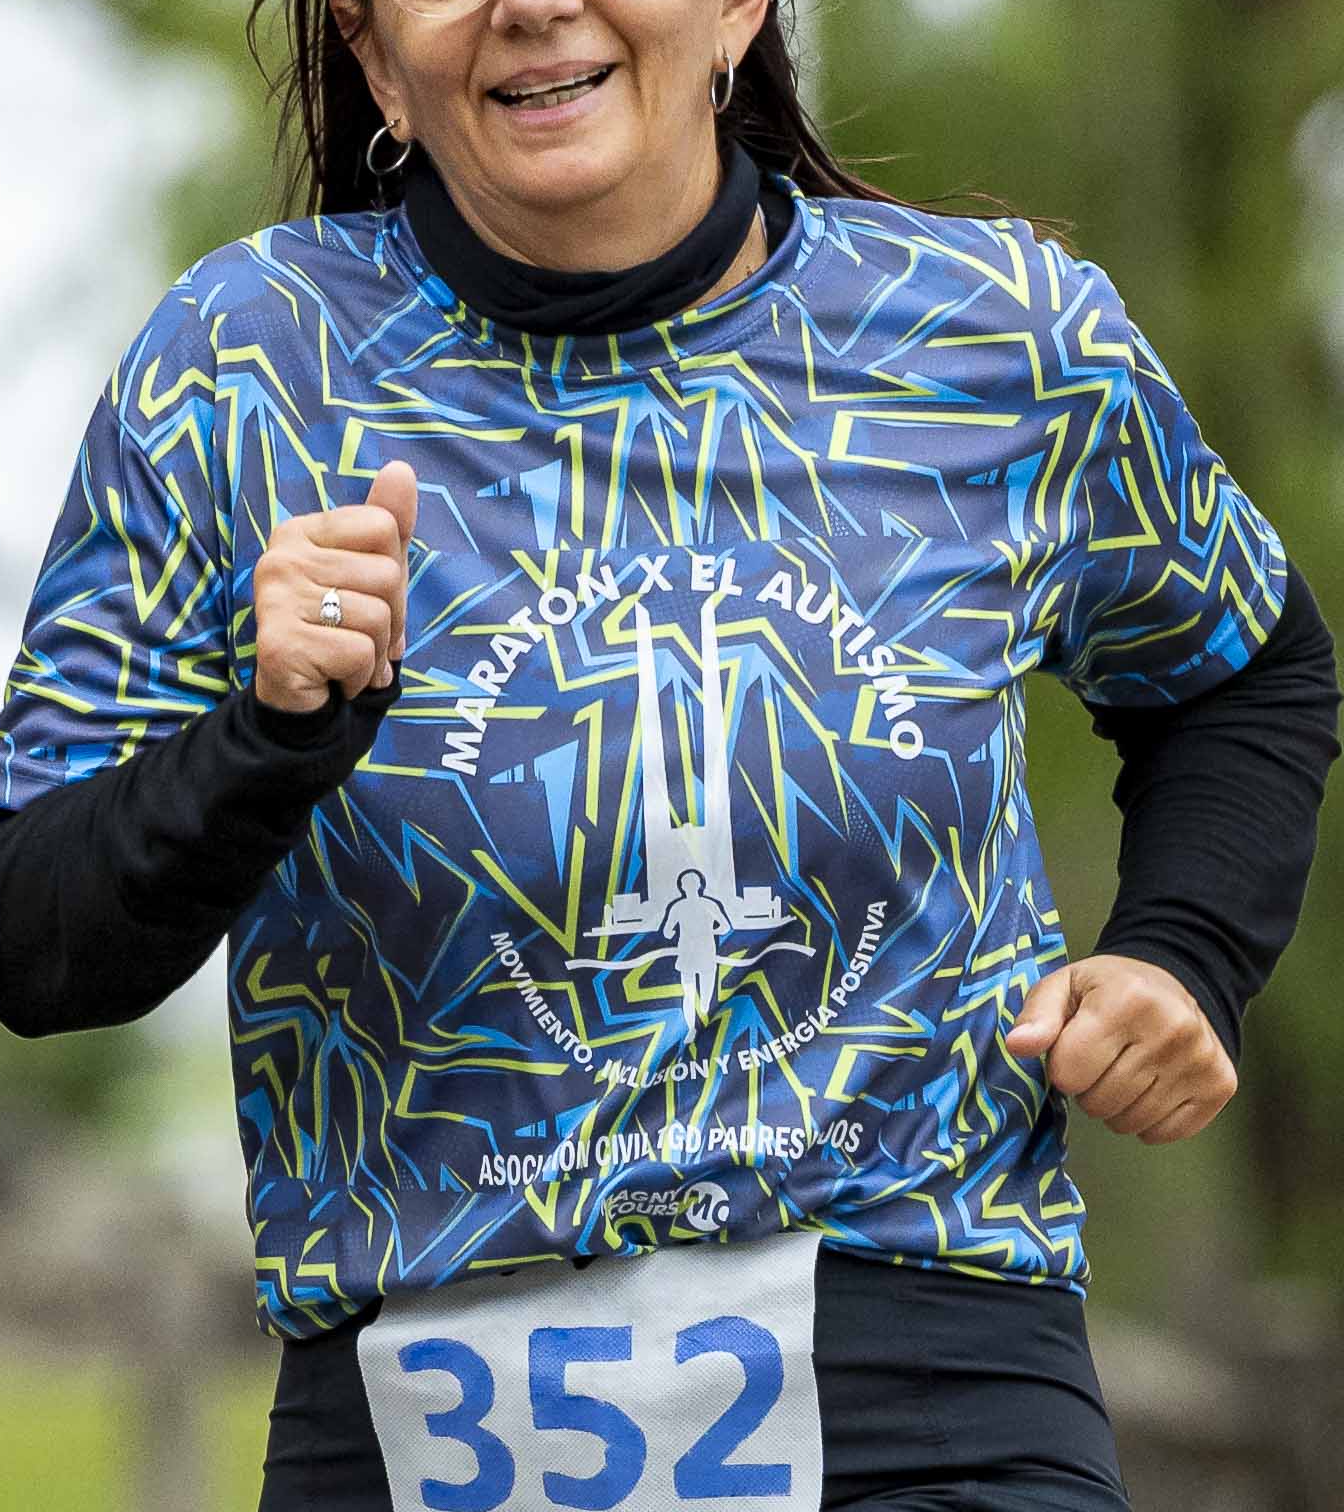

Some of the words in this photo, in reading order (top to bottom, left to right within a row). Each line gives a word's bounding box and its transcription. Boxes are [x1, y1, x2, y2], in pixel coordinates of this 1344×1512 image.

[636, 554, 674, 594] X
[690, 554, 743, 597] EL
[755, 570, 924, 760] AUTISMO
[490, 931, 594, 1073] MOVIMIENTO,
[715, 1054, 731, 1075] Y
[736, 1005, 838, 1071] ENERGÍA
[829, 900, 888, 1008] POSITIVA
[707, 1124, 806, 1160] PADRES
